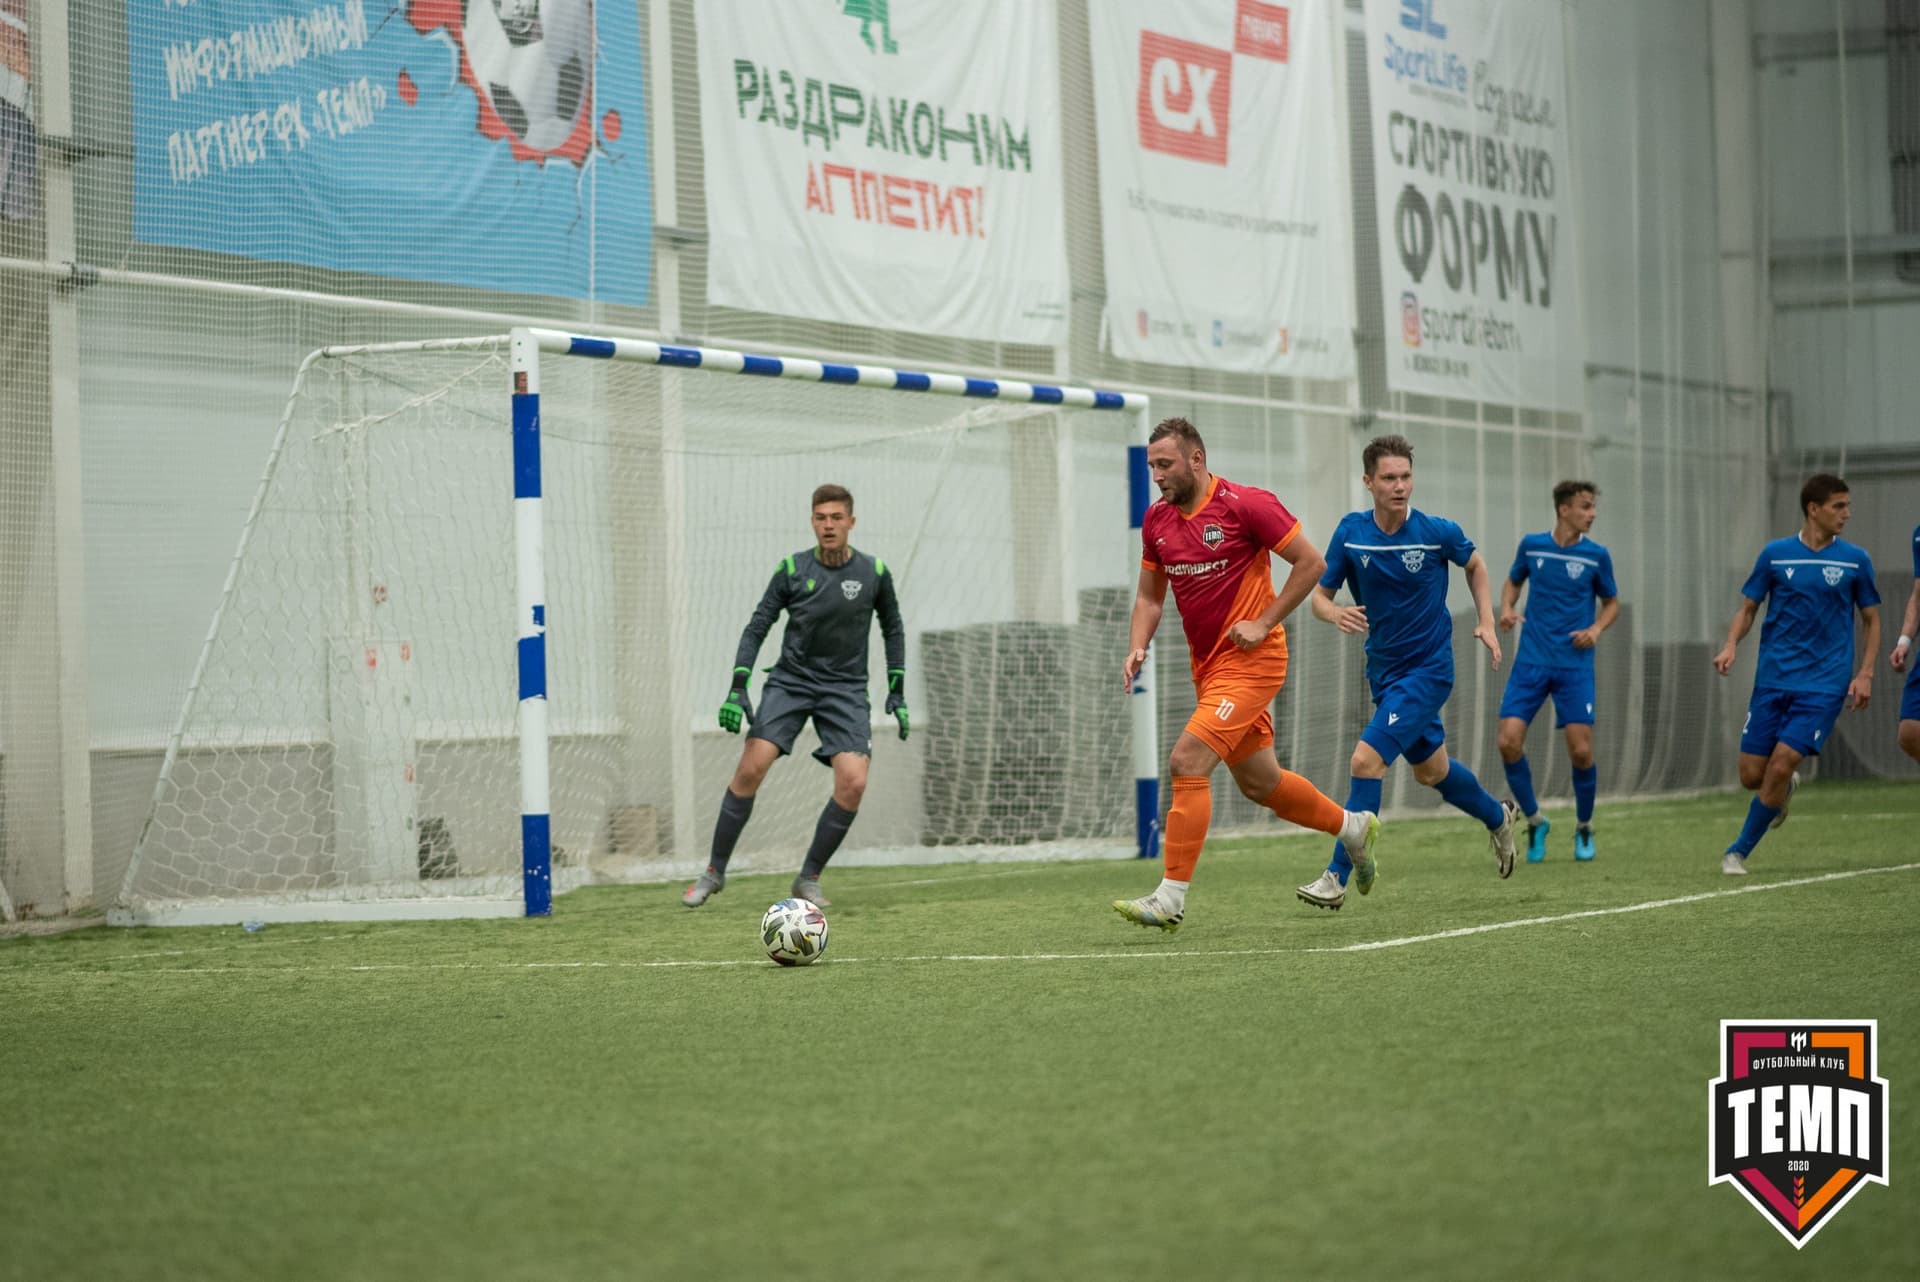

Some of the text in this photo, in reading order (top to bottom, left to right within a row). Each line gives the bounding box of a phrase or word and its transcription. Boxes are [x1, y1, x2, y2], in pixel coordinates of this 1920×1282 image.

[168, 109, 268, 187] ПАРТНЕР
[273, 96, 310, 151] ФК
[734, 59, 1032, 173] РАЗДРАКОНИМ
[806, 160, 986, 239] АППЕТИТ!
[1394, 183, 1557, 309] ФОРМУ
[1215, 698, 1236, 721] 10
